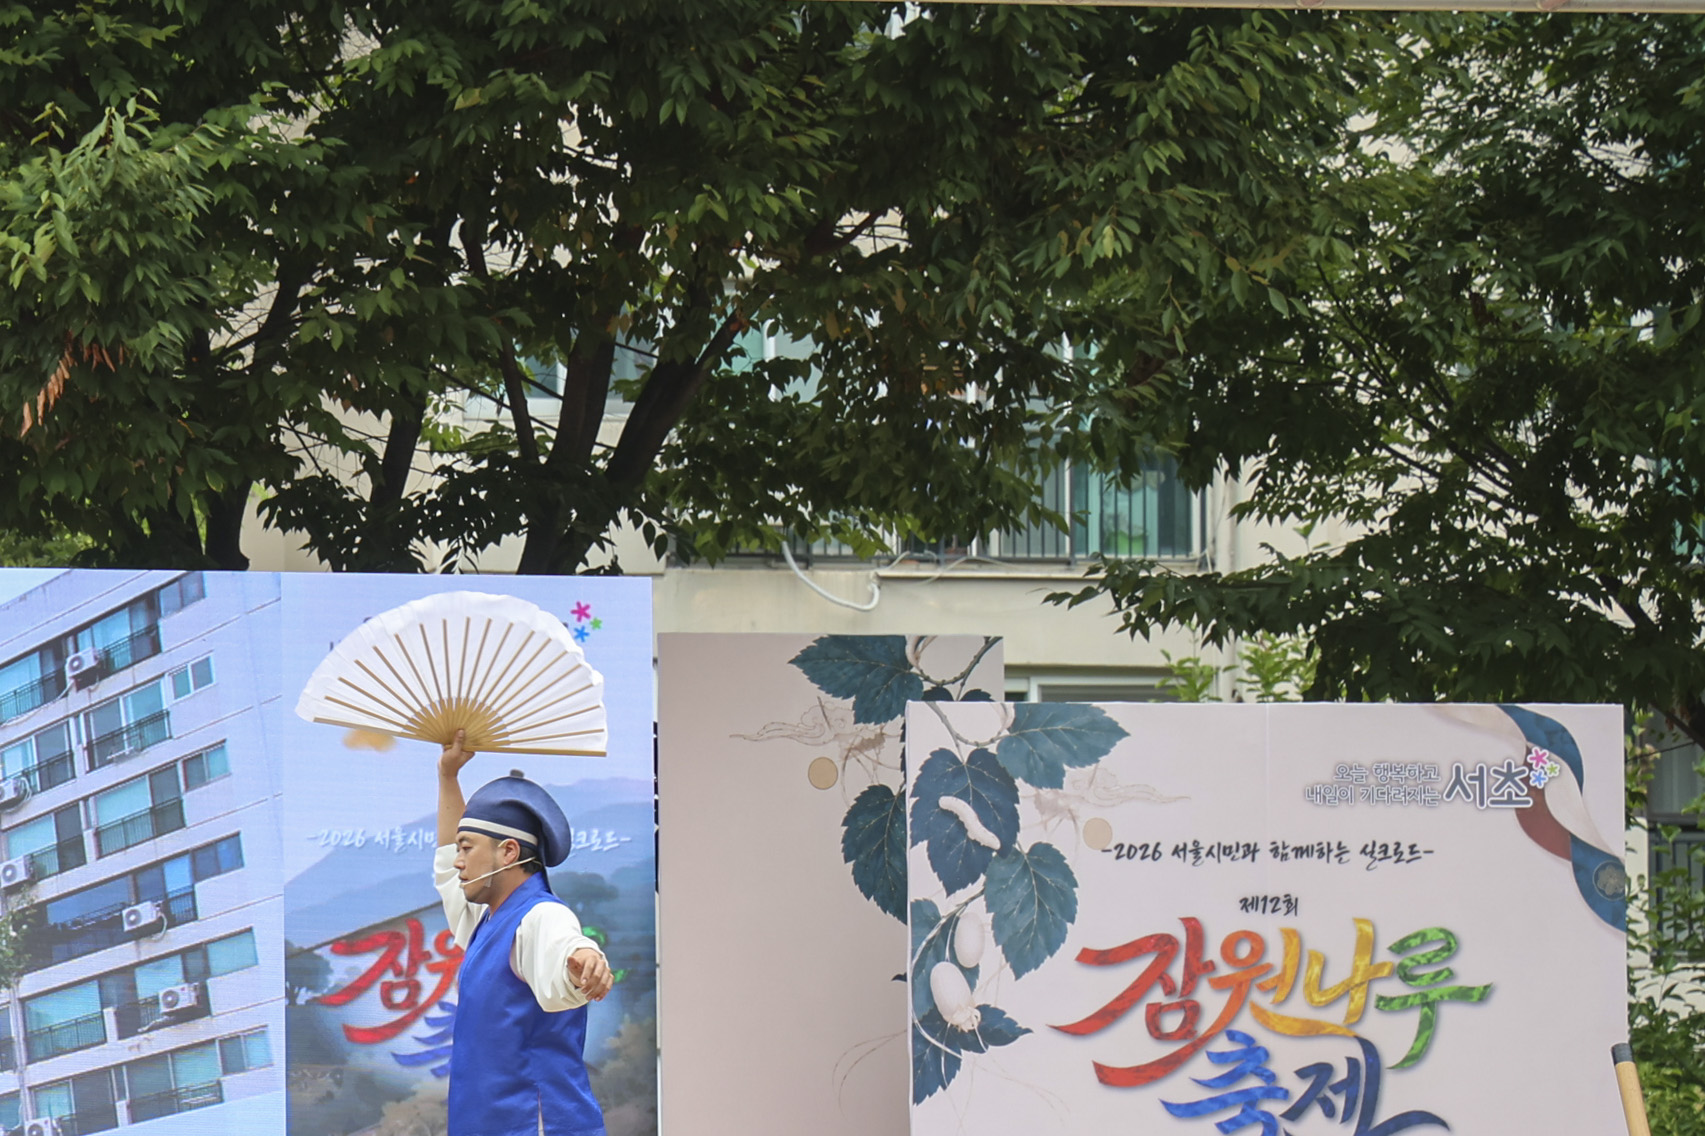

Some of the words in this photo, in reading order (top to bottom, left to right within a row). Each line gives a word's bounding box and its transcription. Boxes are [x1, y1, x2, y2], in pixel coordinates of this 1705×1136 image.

[1333, 763, 1369, 783] 오늘
[1373, 763, 1441, 783] 행복하고
[1443, 760, 1534, 809] 서초
[1304, 785, 1355, 805] 내일이
[1359, 785, 1441, 806] 기다려지는
[307, 829, 365, 849] -2026
[570, 827, 632, 854] 크로드-
[1101, 841, 1163, 862] -2026
[1171, 839, 1261, 867] 서울시민과
[1268, 840, 1351, 864] 함께하는
[1359, 840, 1435, 871] 실크로드-
[1239, 894, 1299, 917] 제12회
[1048, 916, 1494, 1088] 잠원나루
